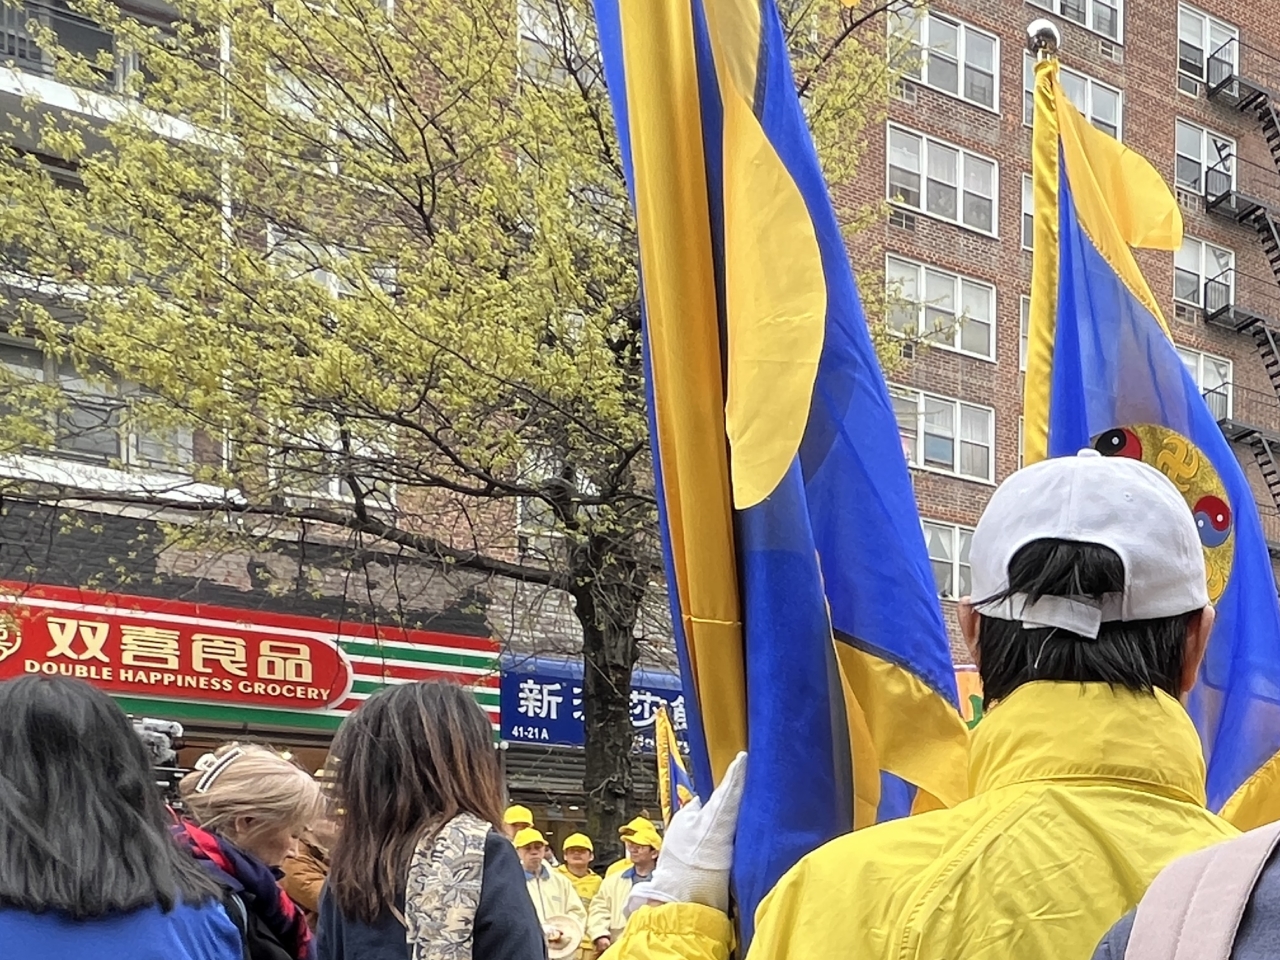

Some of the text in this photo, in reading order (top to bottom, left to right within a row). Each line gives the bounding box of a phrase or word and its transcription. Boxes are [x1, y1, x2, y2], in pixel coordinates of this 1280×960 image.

[46, 616, 313, 684] 双喜食品
[24, 659, 331, 701] DOUBLE HAPPINESS GROCERY
